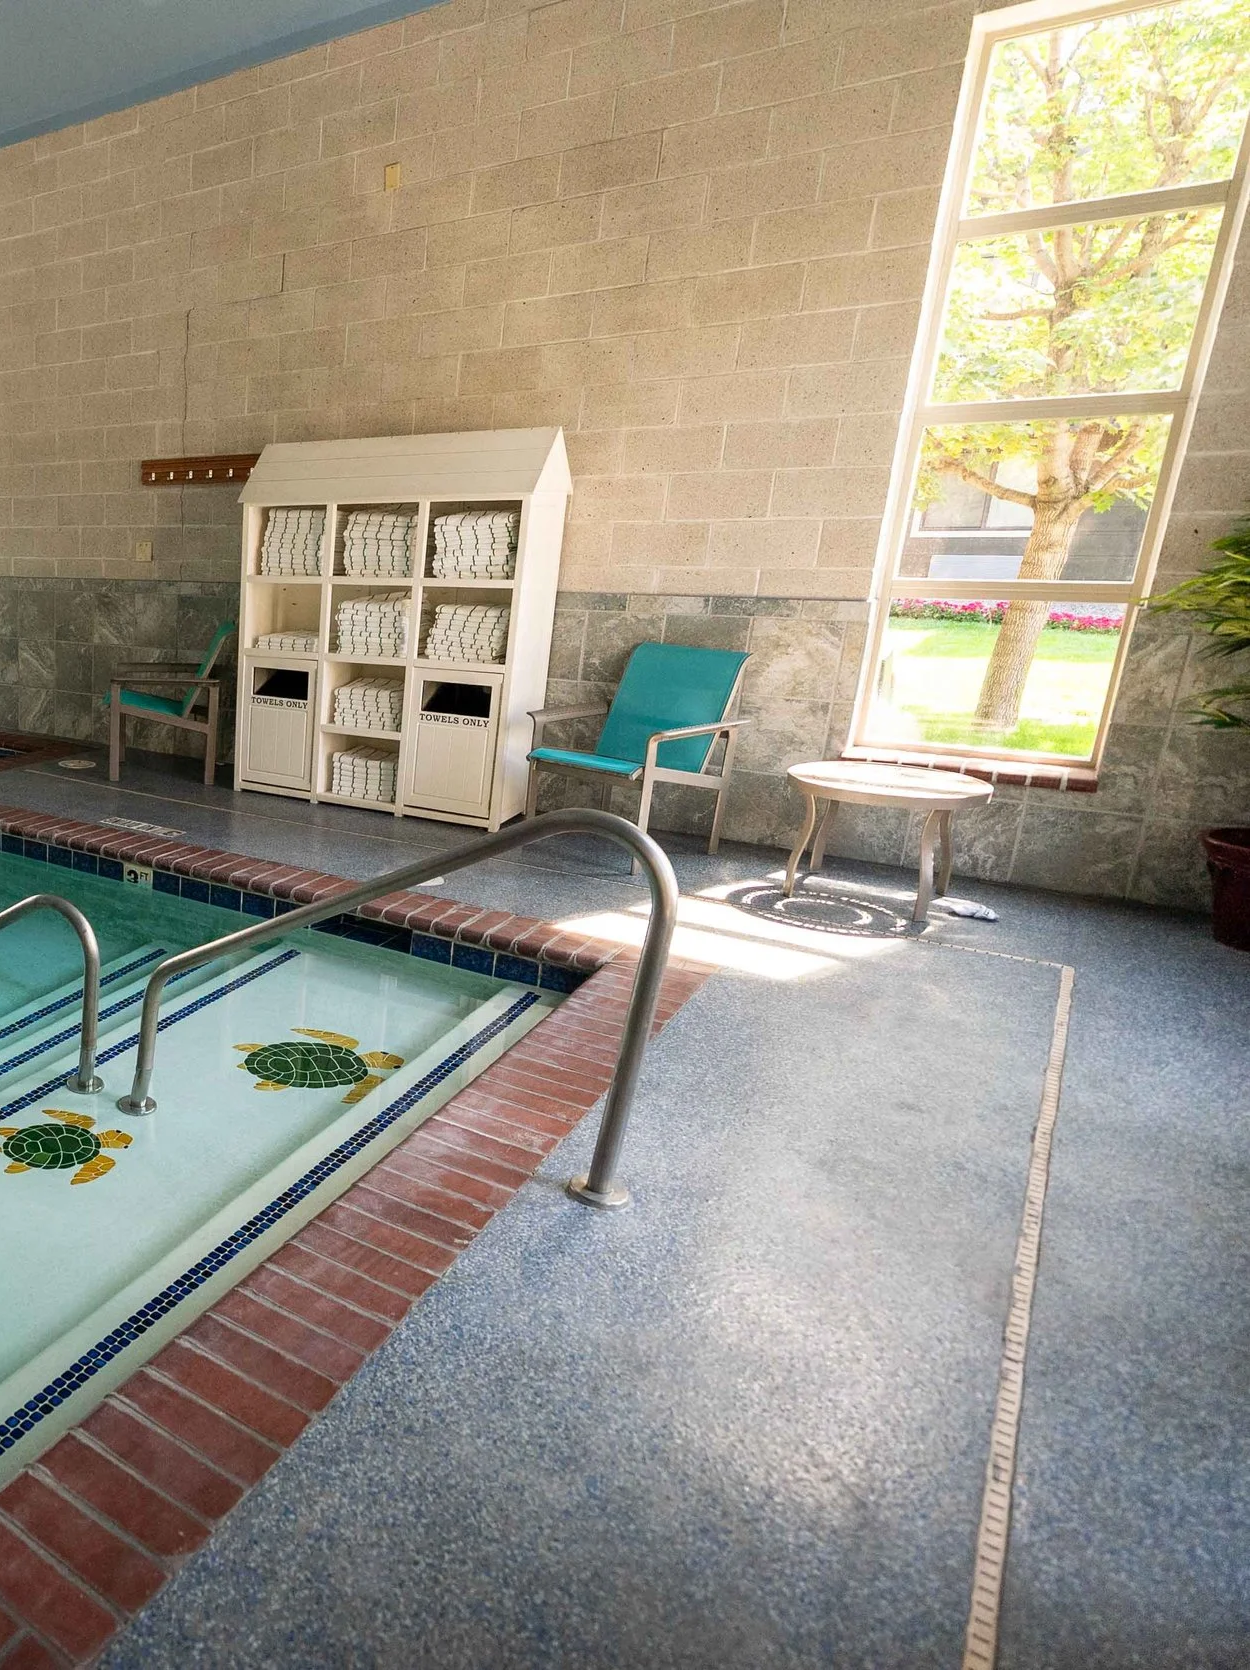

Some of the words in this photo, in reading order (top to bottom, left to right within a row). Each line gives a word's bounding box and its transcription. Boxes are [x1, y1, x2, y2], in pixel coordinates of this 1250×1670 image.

[251, 696, 284, 706] TOWELS
[286, 700, 308, 709] ONLY
[419, 713, 459, 724] TOWELS
[462, 718, 489, 728] ONLY
[140, 871, 148, 881] FT
